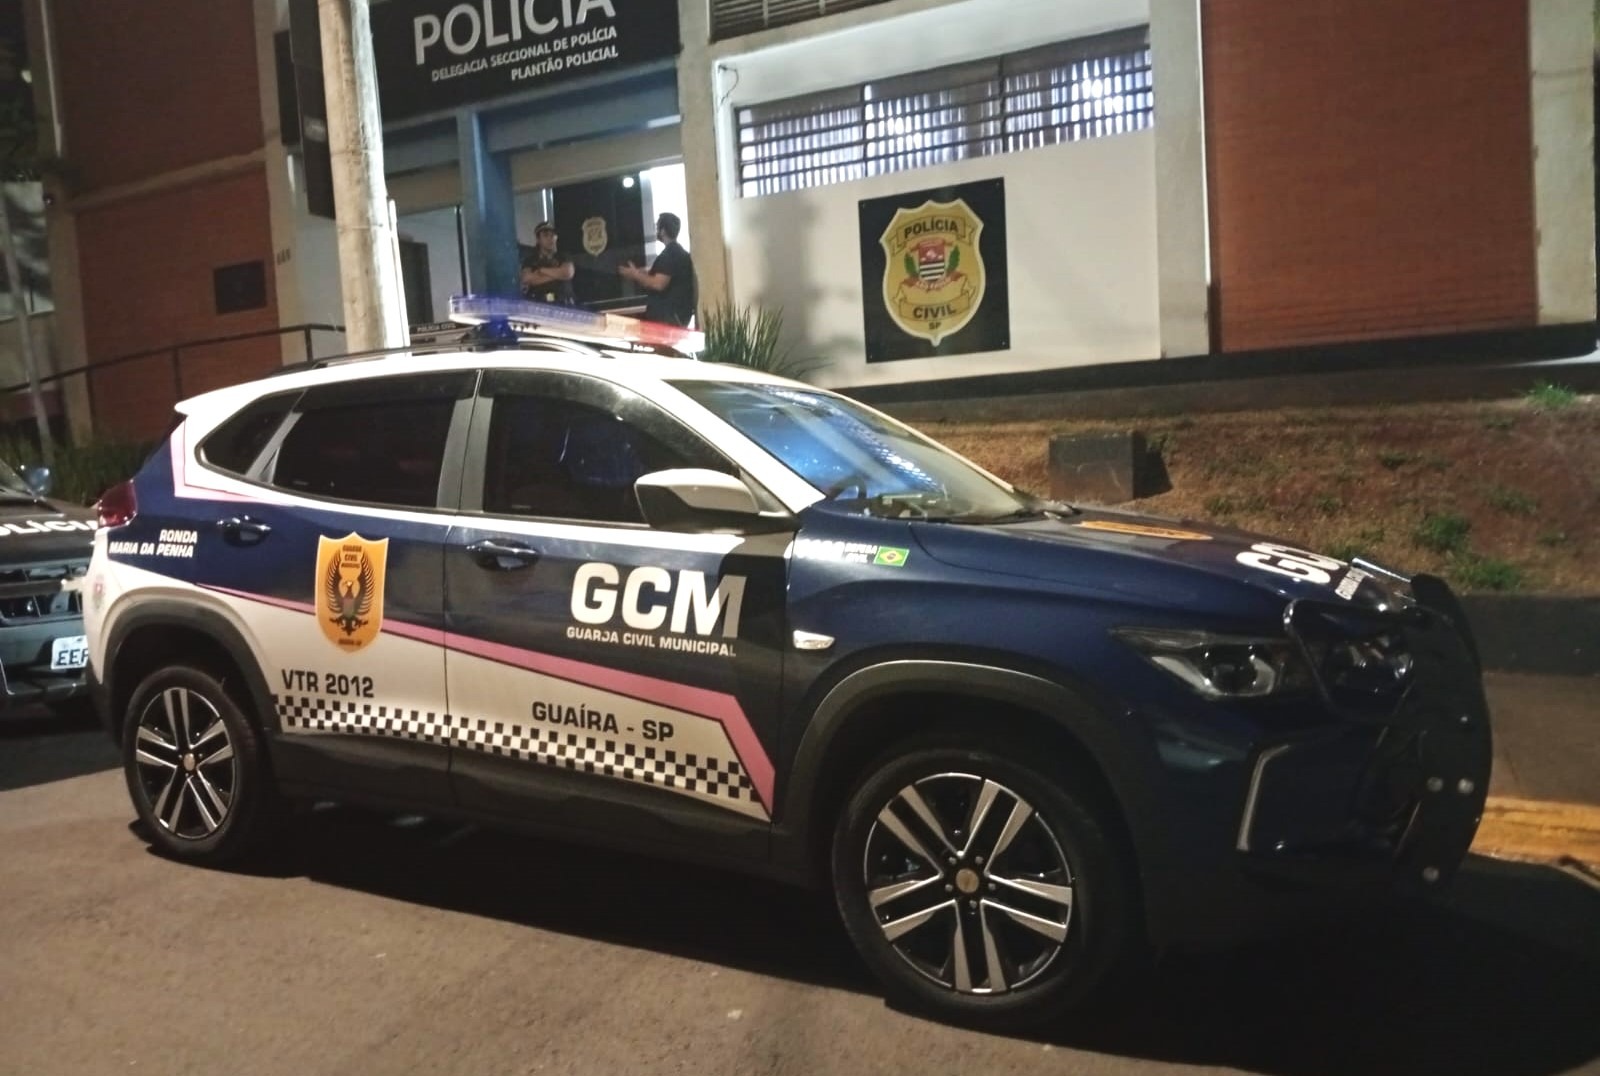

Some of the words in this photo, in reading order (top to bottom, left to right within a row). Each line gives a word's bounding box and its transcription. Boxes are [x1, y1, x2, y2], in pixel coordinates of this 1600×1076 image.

[432, 60, 488, 82] DELEGACIA
[490, 42, 551, 66] SECCIONAL
[553, 38, 569, 52] DE
[571, 25, 618, 48] POLÍCIA
[511, 57, 563, 81] PLANTÃO
[566, 45, 619, 68] POLICIAL
[904, 216, 959, 239] POLÍCIA
[913, 304, 957, 320] CIVIL
[928, 322, 942, 331] SP
[159, 529, 198, 544] RONDA
[108, 541, 139, 555] MARIA
[139, 542, 155, 555] DA
[156, 543, 194, 558] PENHA
[570, 562, 748, 640] GCM
[623, 632, 655, 648] CIVIL
[659, 636, 737, 657] MUNICIPAL
[281, 669, 319, 693] VTR
[325, 673, 374, 698] 2012
[532, 701, 619, 734] GUAÍRA
[642, 719, 674, 742] SP
